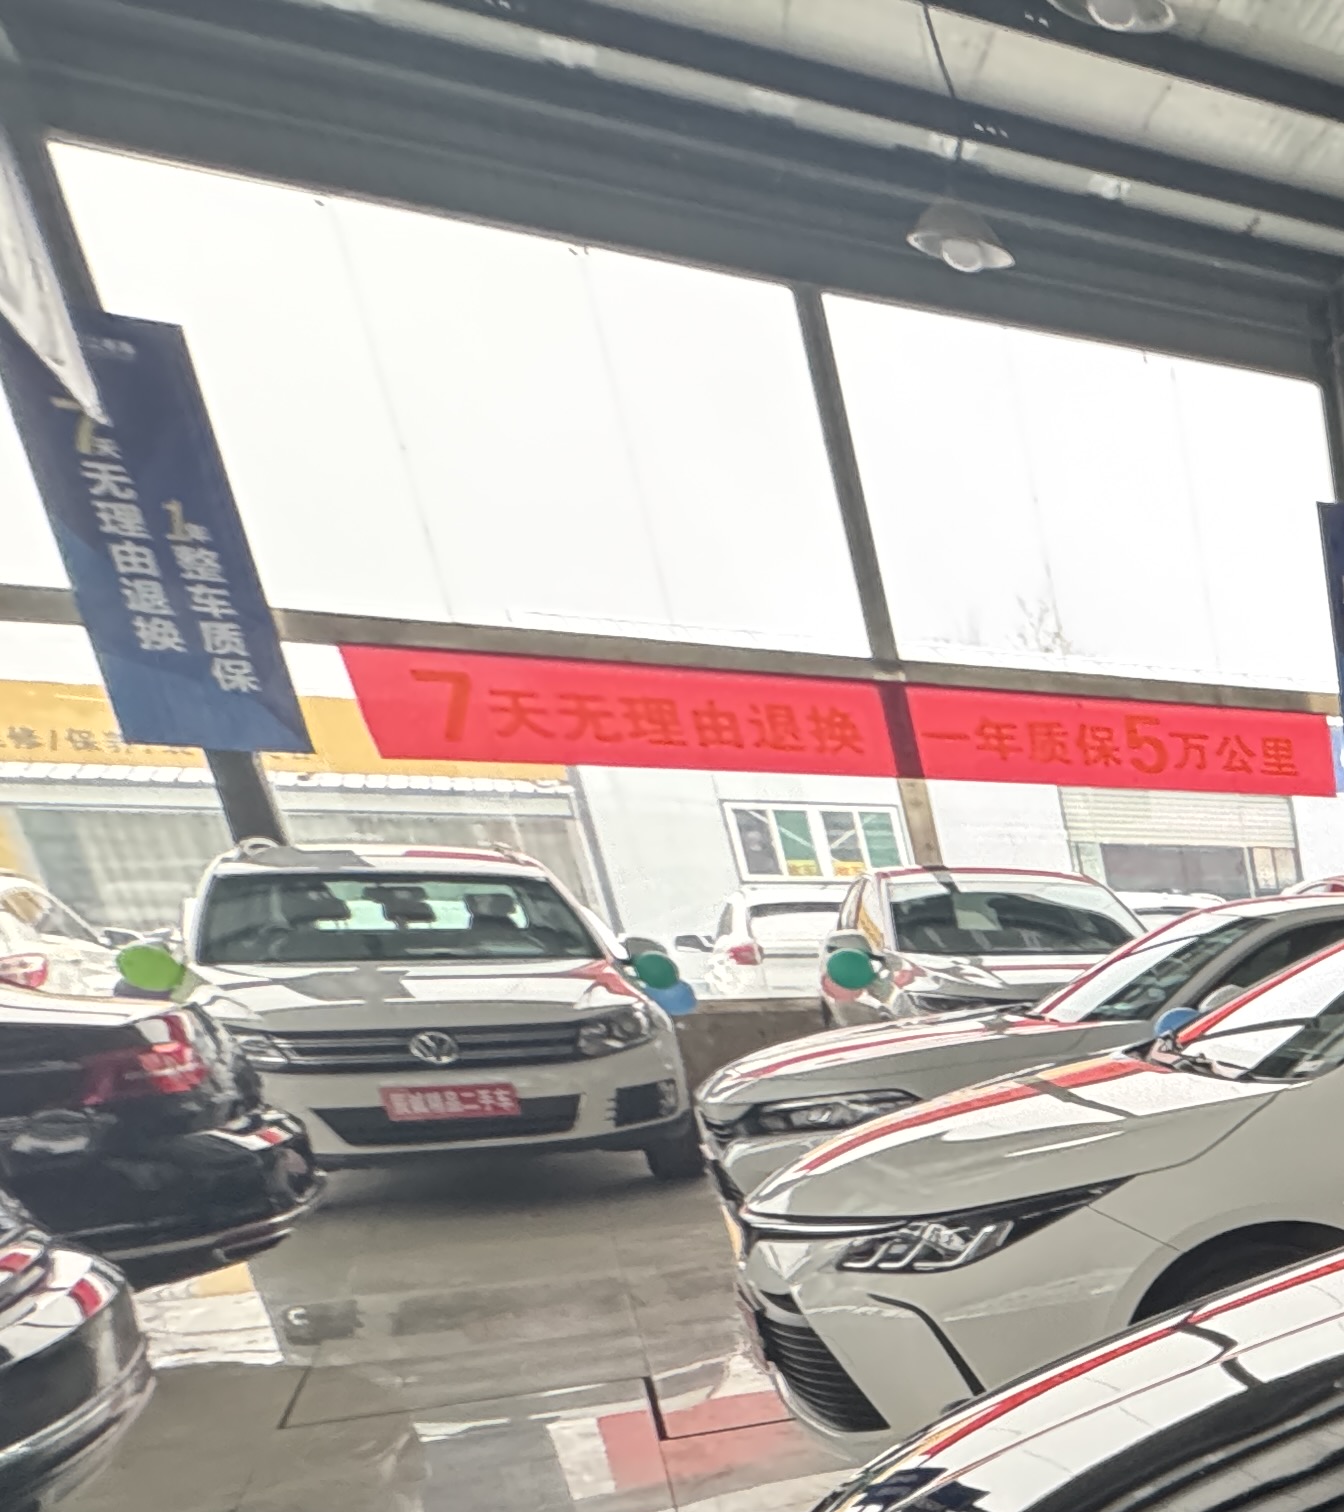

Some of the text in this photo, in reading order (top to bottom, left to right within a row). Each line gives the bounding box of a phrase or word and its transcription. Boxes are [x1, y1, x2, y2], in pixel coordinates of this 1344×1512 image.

[162, 498, 263, 693] 1年整车质保
[409, 668, 866, 756] 7天无理由退换
[921, 714, 1300, 778] 一年质保5万公里
